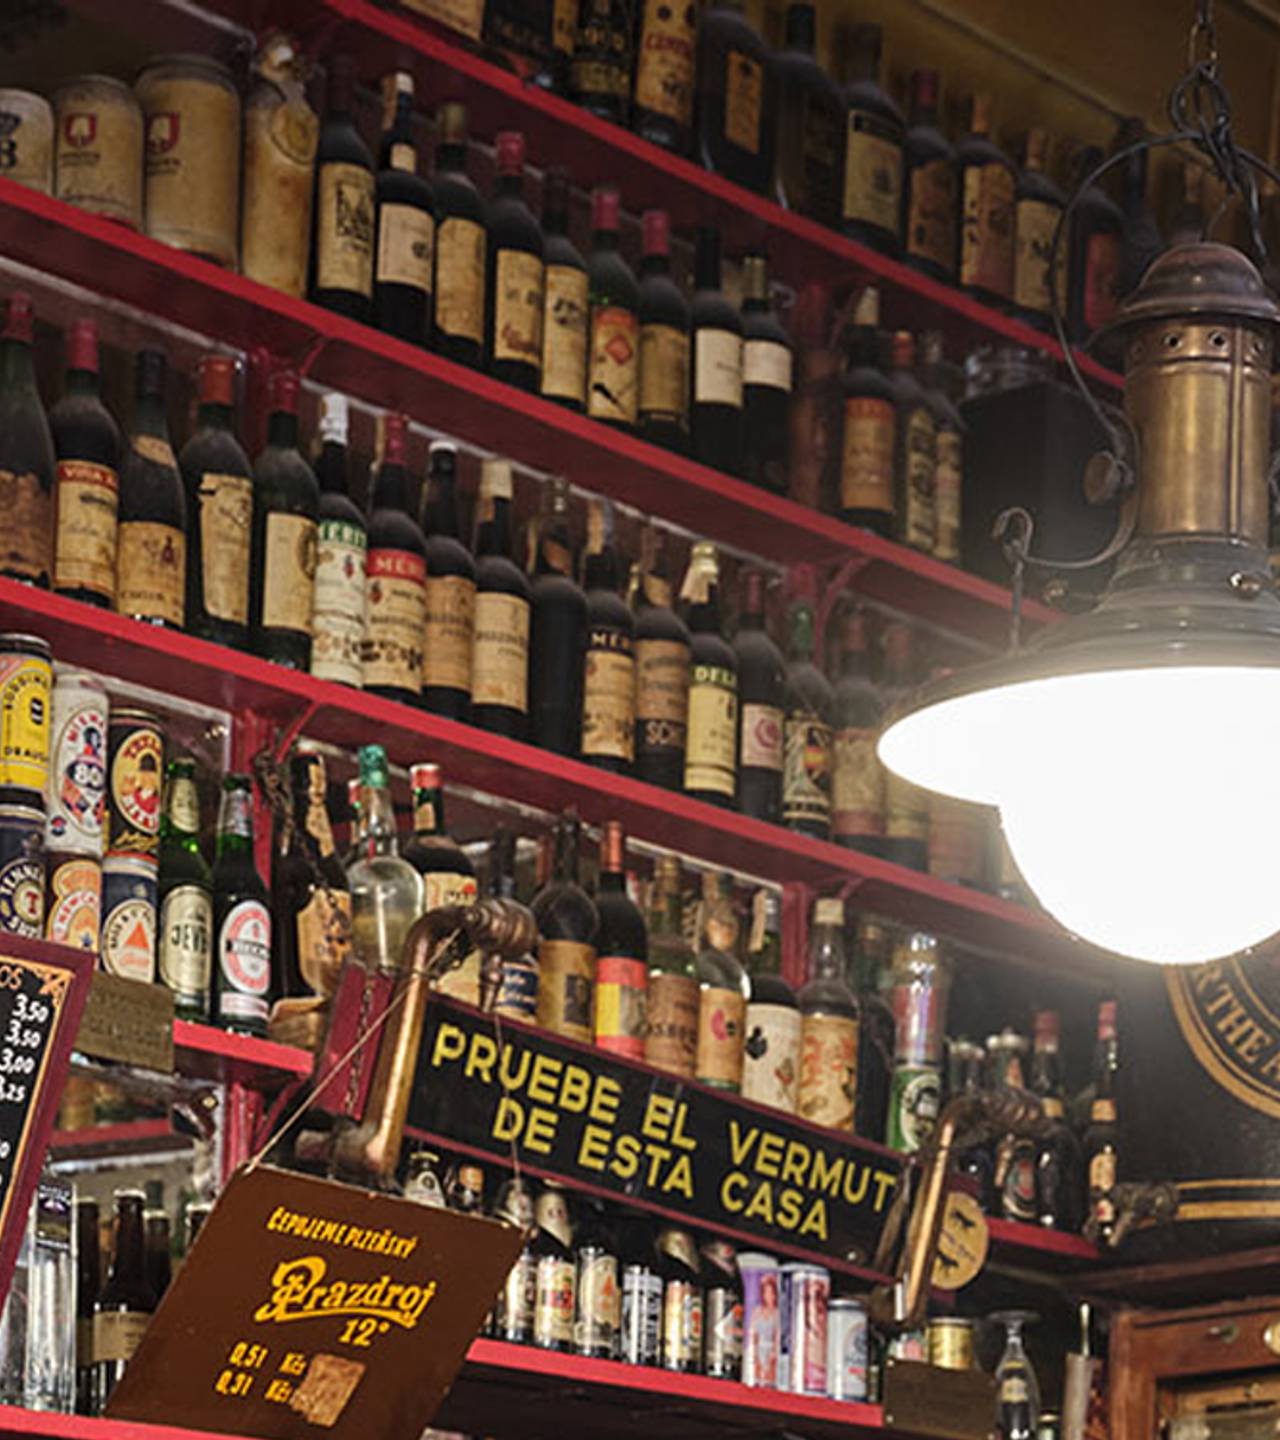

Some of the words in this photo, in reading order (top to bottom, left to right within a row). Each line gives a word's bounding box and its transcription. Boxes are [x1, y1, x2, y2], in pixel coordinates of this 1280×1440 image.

[1205, 982, 1270, 1064] THE
[431, 1022, 622, 1127] PRUEBE
[641, 1093, 697, 1152] EL
[729, 1121, 898, 1213] VERMUT
[491, 1097, 559, 1155] DE
[577, 1124, 695, 1200] ESTA
[720, 1172, 829, 1242] CASA
[254, 1256, 436, 1329] Prazdroj
